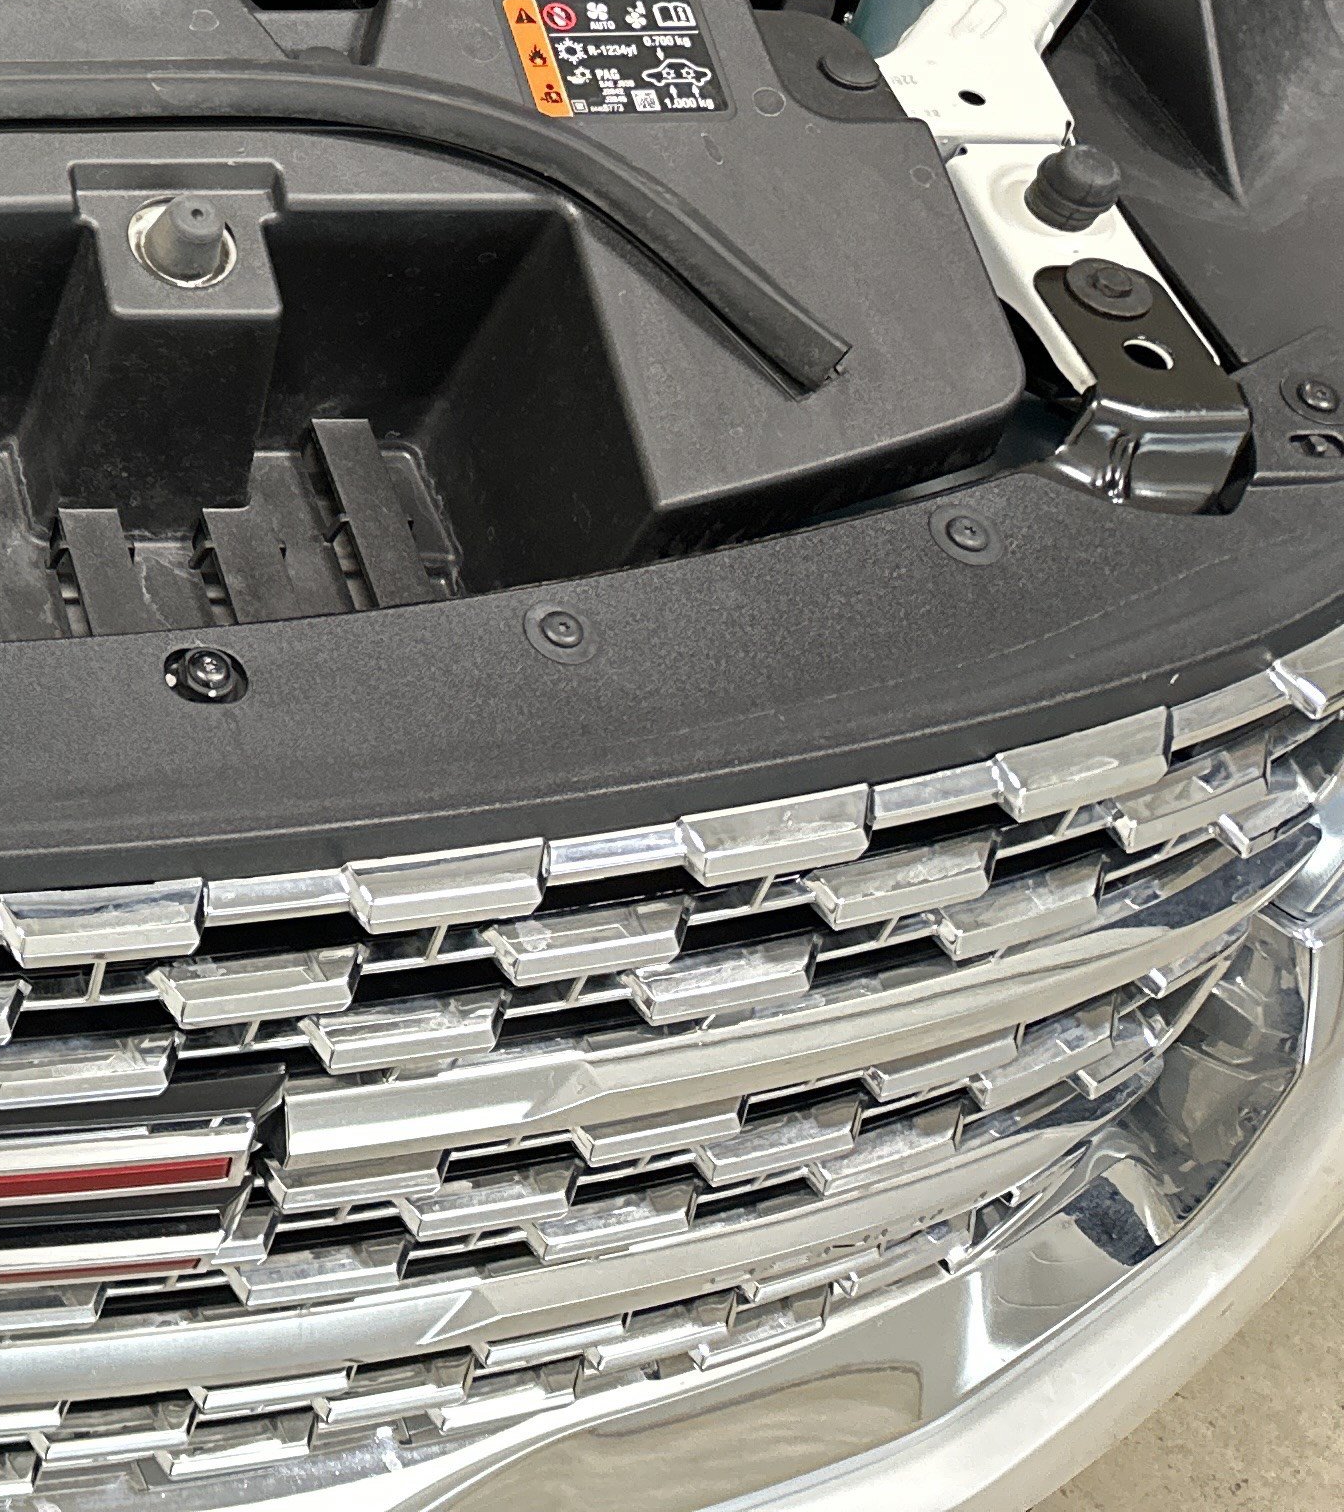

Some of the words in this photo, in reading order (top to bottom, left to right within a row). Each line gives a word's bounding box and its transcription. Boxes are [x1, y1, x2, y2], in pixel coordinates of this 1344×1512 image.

[589, 20, 616, 30] AUTO
[642, 35, 674, 47] 0.700
[674, 35, 692, 48] kg
[594, 68, 621, 81] PAG
[697, 97, 715, 110] kg
